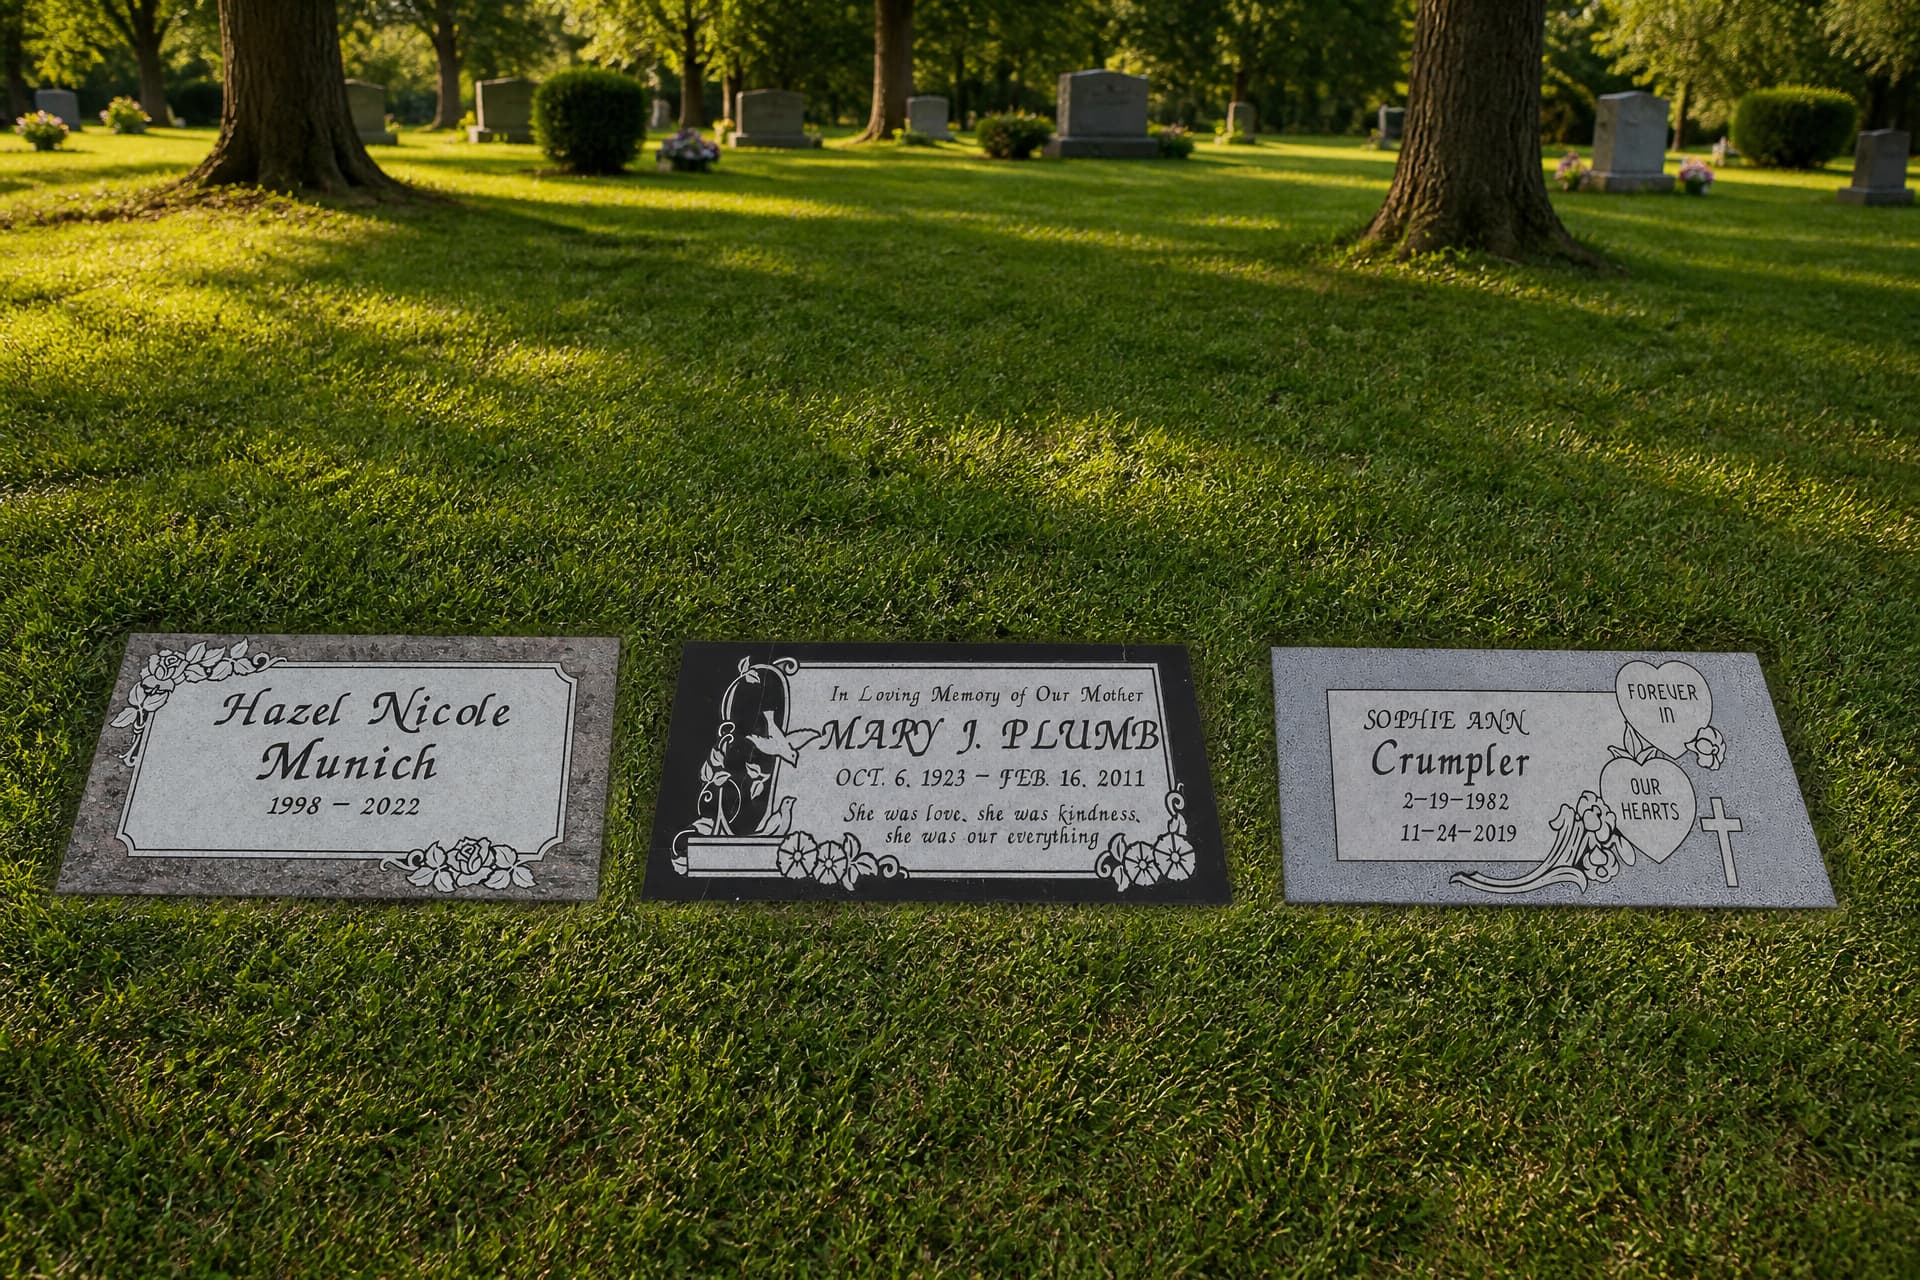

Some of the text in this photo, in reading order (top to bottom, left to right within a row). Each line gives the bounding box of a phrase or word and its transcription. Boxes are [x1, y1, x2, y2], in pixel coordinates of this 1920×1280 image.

[829, 683, 1144, 708] In Loving Memory of Our Mother
[1627, 683, 1699, 701] FOREVER
[213, 686, 511, 734] Hazel Nicole
[1363, 708, 1531, 736] SOPHIE ANN
[817, 715, 1160, 758] MARY J. PLUMB
[255, 736, 438, 781] Munich
[1371, 738, 1530, 787] Crumpler
[835, 766, 885, 787] OCT.
[920, 768, 965, 788] 1923
[998, 768, 1049, 790] FEB.
[1096, 768, 1145, 788] 2011
[1630, 777, 1662, 796] OUR
[266, 796, 322, 816] 1998
[359, 796, 420, 816] 2022
[843, 801, 875, 823] She
[883, 808, 918, 822] was
[977, 803, 1004, 822] she
[1013, 808, 1049, 822] was
[1402, 791, 1510, 811] 2-19-1982
[1620, 801, 1680, 821] HEARTS
[885, 823, 1100, 851] she was our everything
[1400, 823, 1517, 843] 11-24-2019
